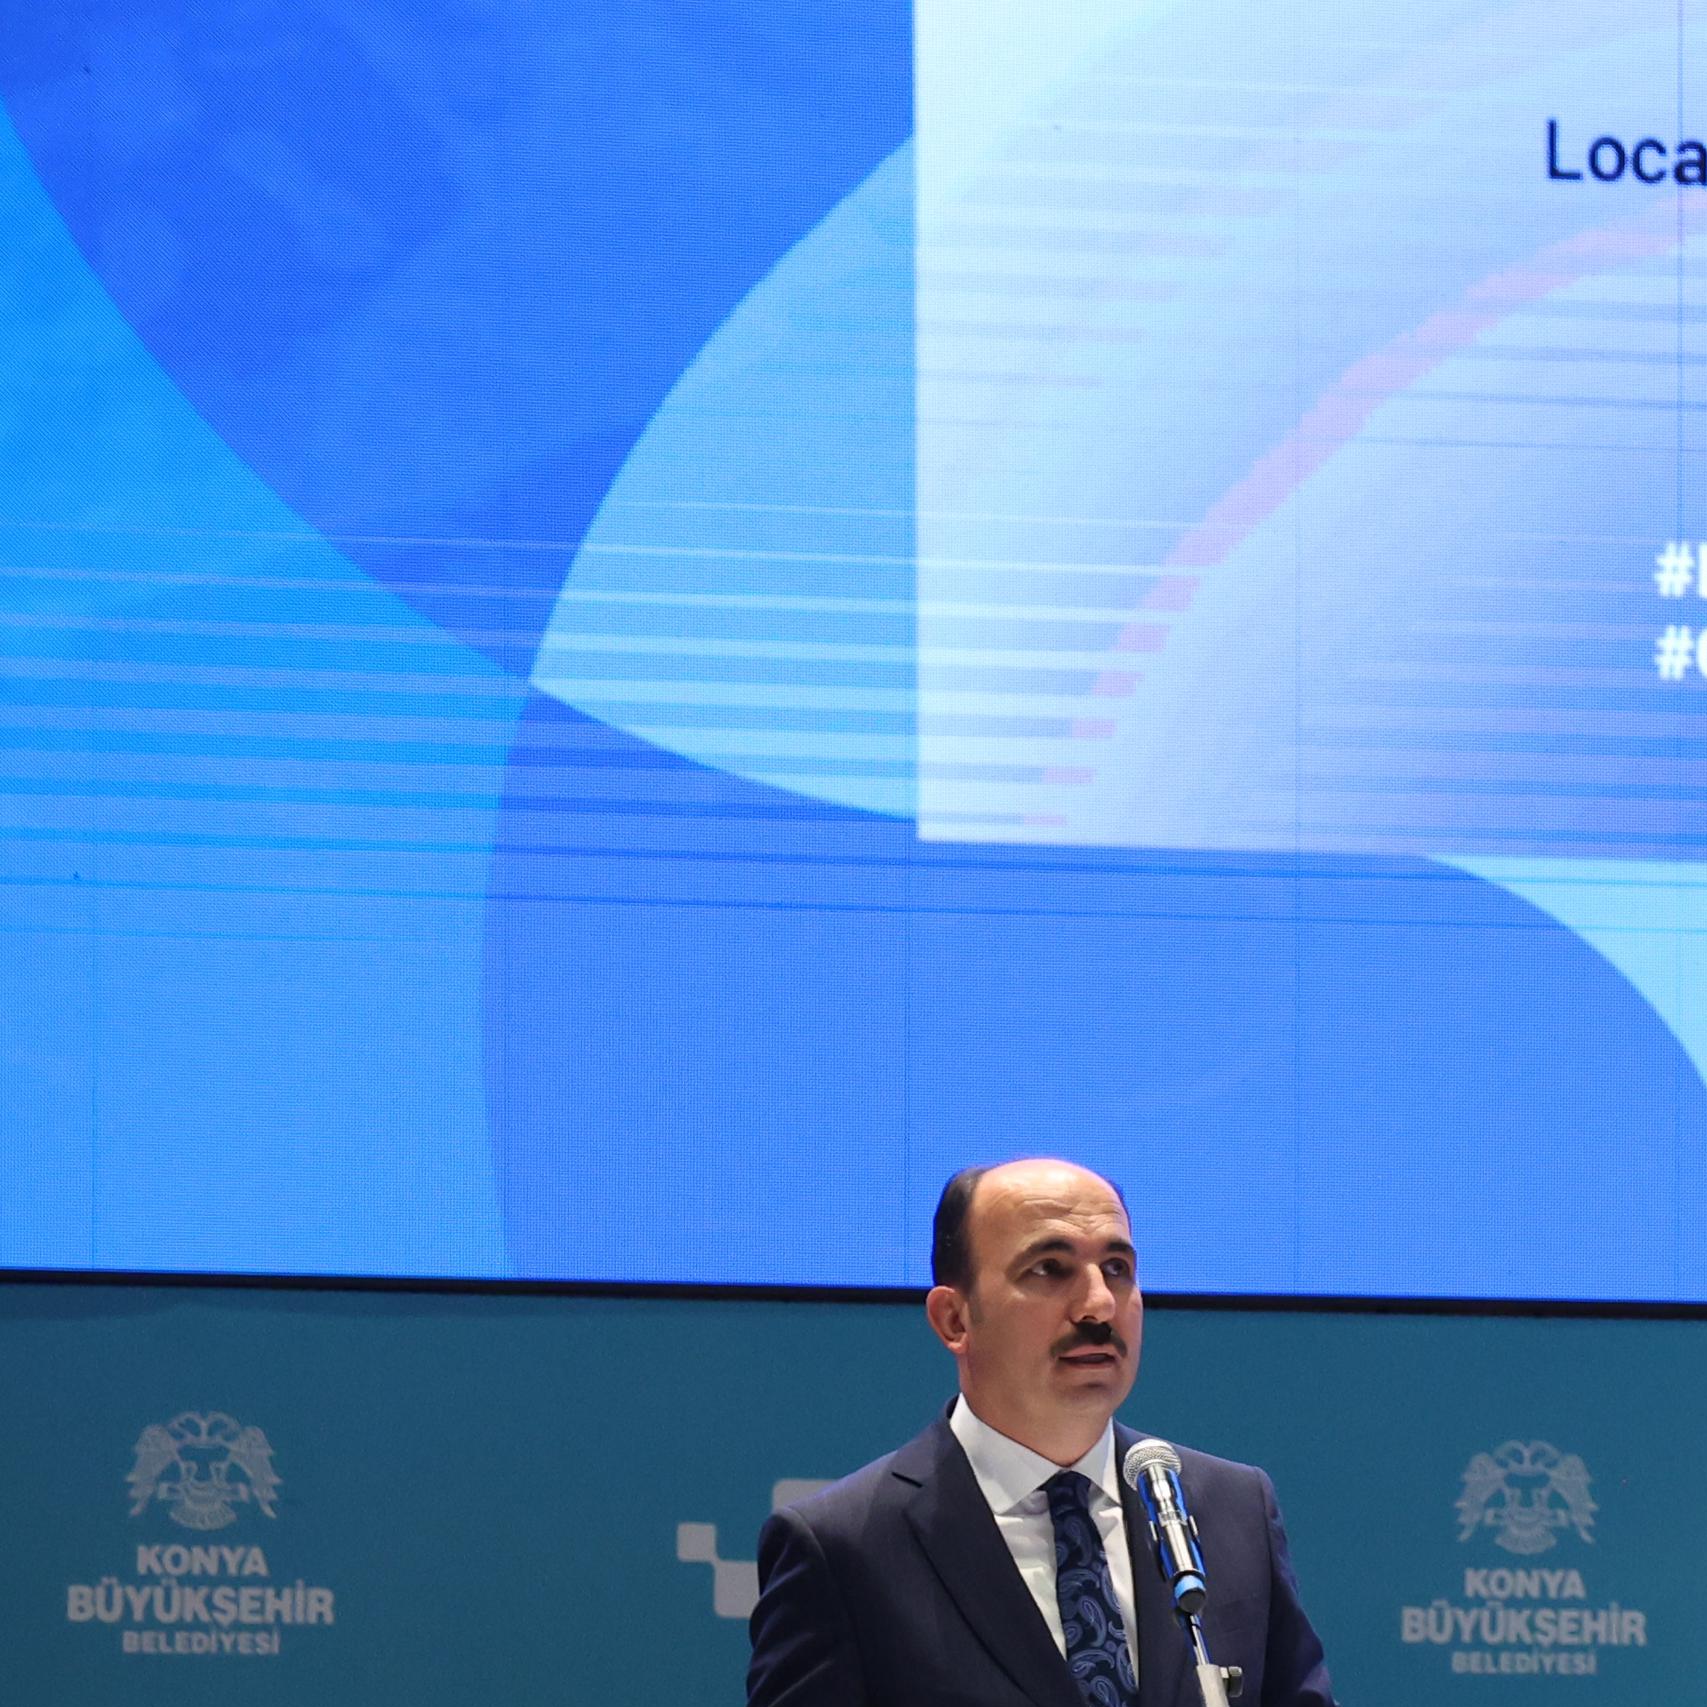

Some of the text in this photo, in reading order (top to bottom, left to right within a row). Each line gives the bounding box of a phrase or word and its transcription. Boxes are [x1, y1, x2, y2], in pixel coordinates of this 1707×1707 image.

[136, 1544, 269, 1577] KONYA
[1464, 1567, 1586, 1601] KONYA
[67, 1576, 335, 1628] BÜYÜKŞEHİR
[1401, 1599, 1648, 1649] BÜYÜKŞEHİR
[122, 1629, 281, 1655] BELEDİYESİ
[1451, 1649, 1597, 1676] BELEDİYESİ
